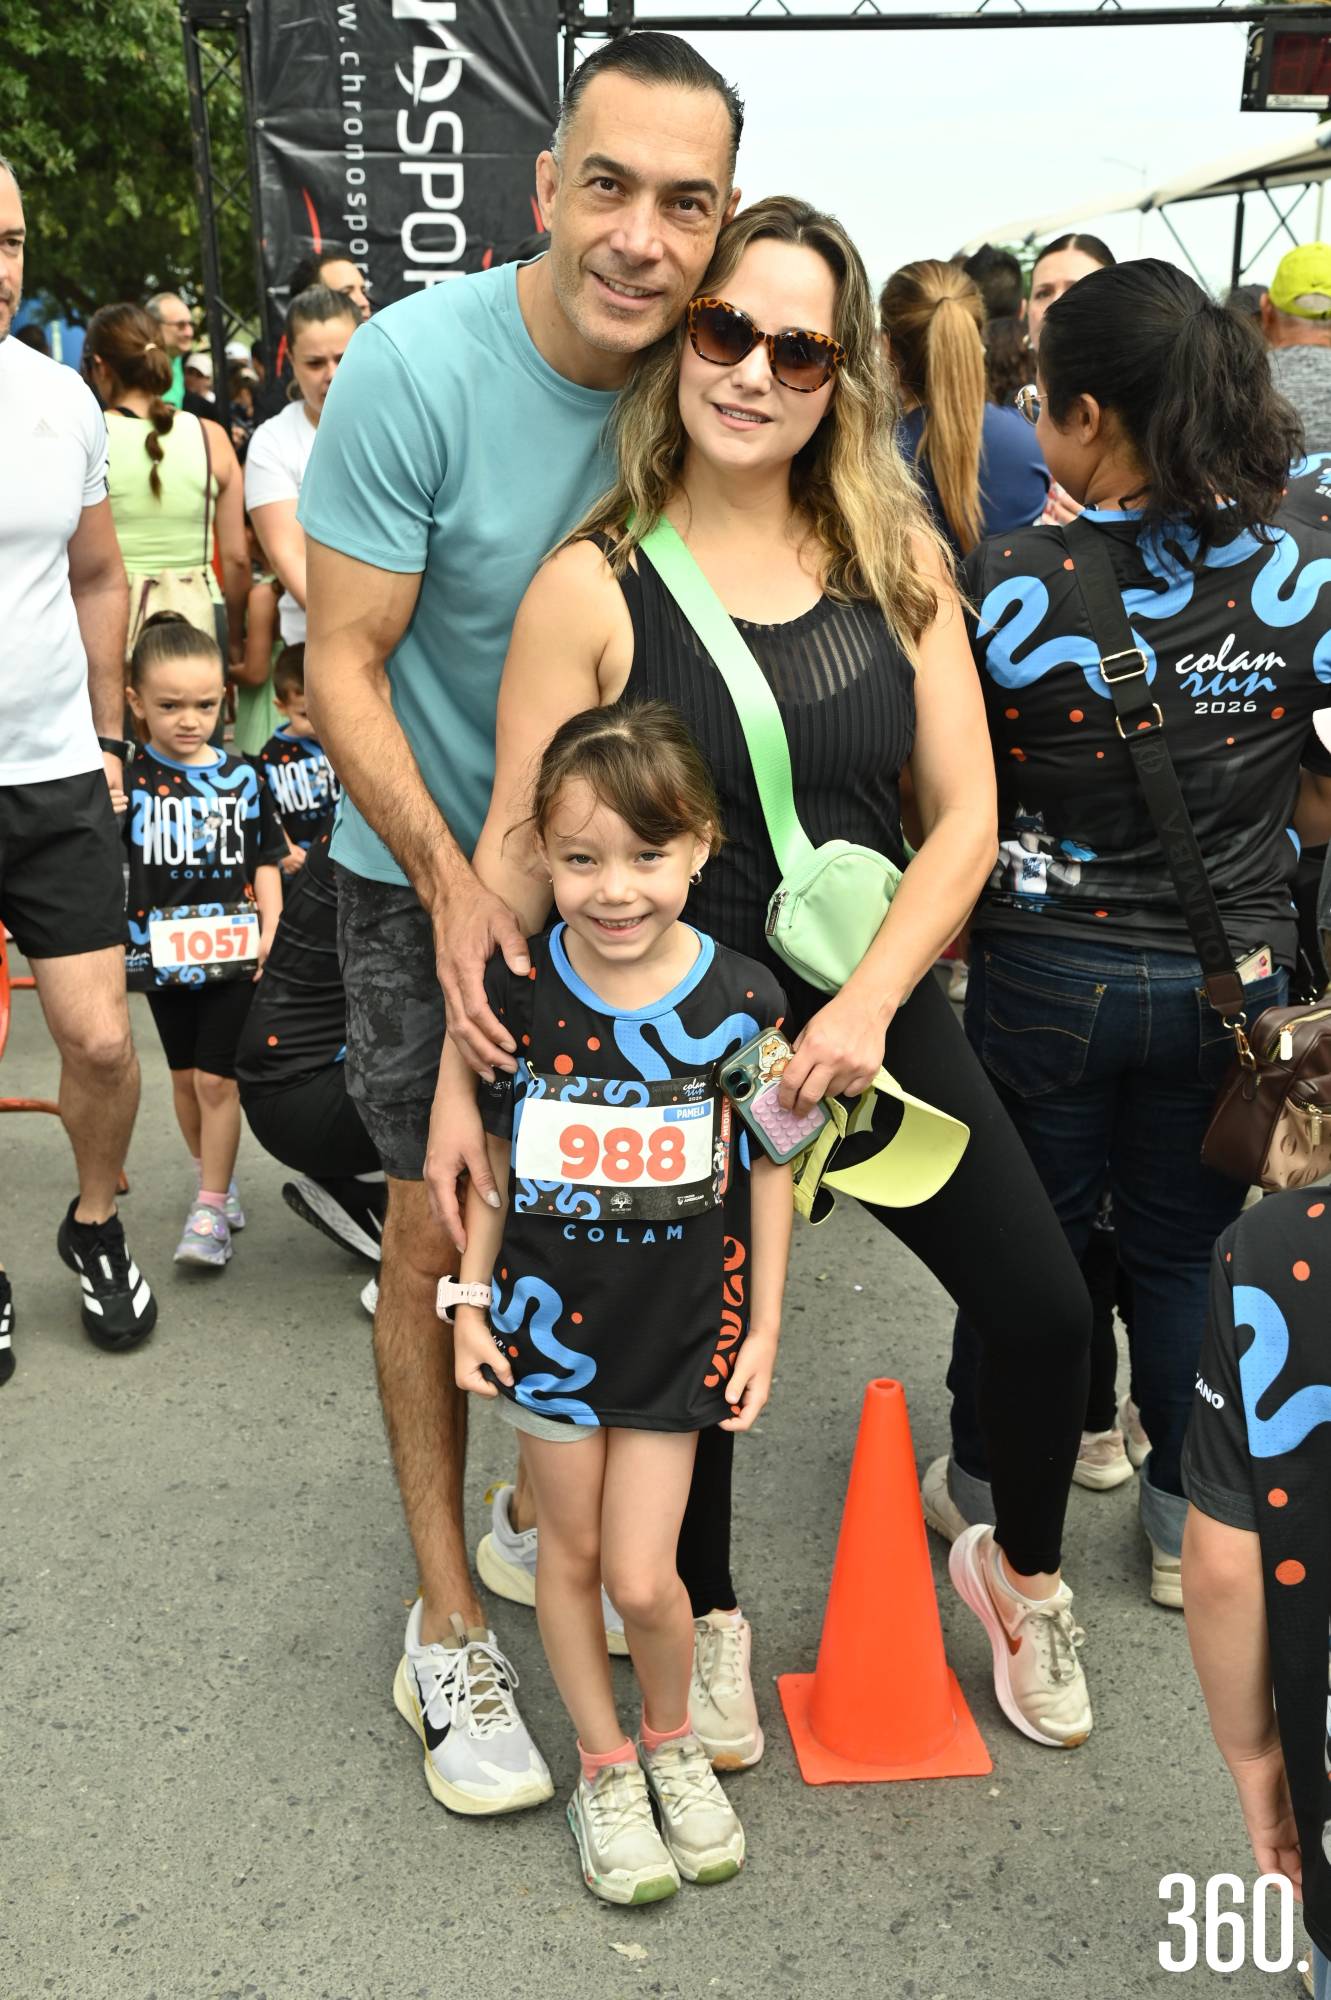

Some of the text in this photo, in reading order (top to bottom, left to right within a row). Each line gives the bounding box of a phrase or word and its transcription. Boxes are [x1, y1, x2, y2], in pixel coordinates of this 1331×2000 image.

[1175, 633, 1287, 674] colam
[1179, 671, 1277, 698] run
[1194, 701, 1257, 715] 2026
[170, 927, 249, 962] 1057
[682, 1078, 706, 1091] colam
[676, 1106, 705, 1119] PAMELA
[559, 1124, 686, 1183] 988
[563, 1224, 683, 1244] COLAM
[1194, 1372, 1225, 1410] ANO
